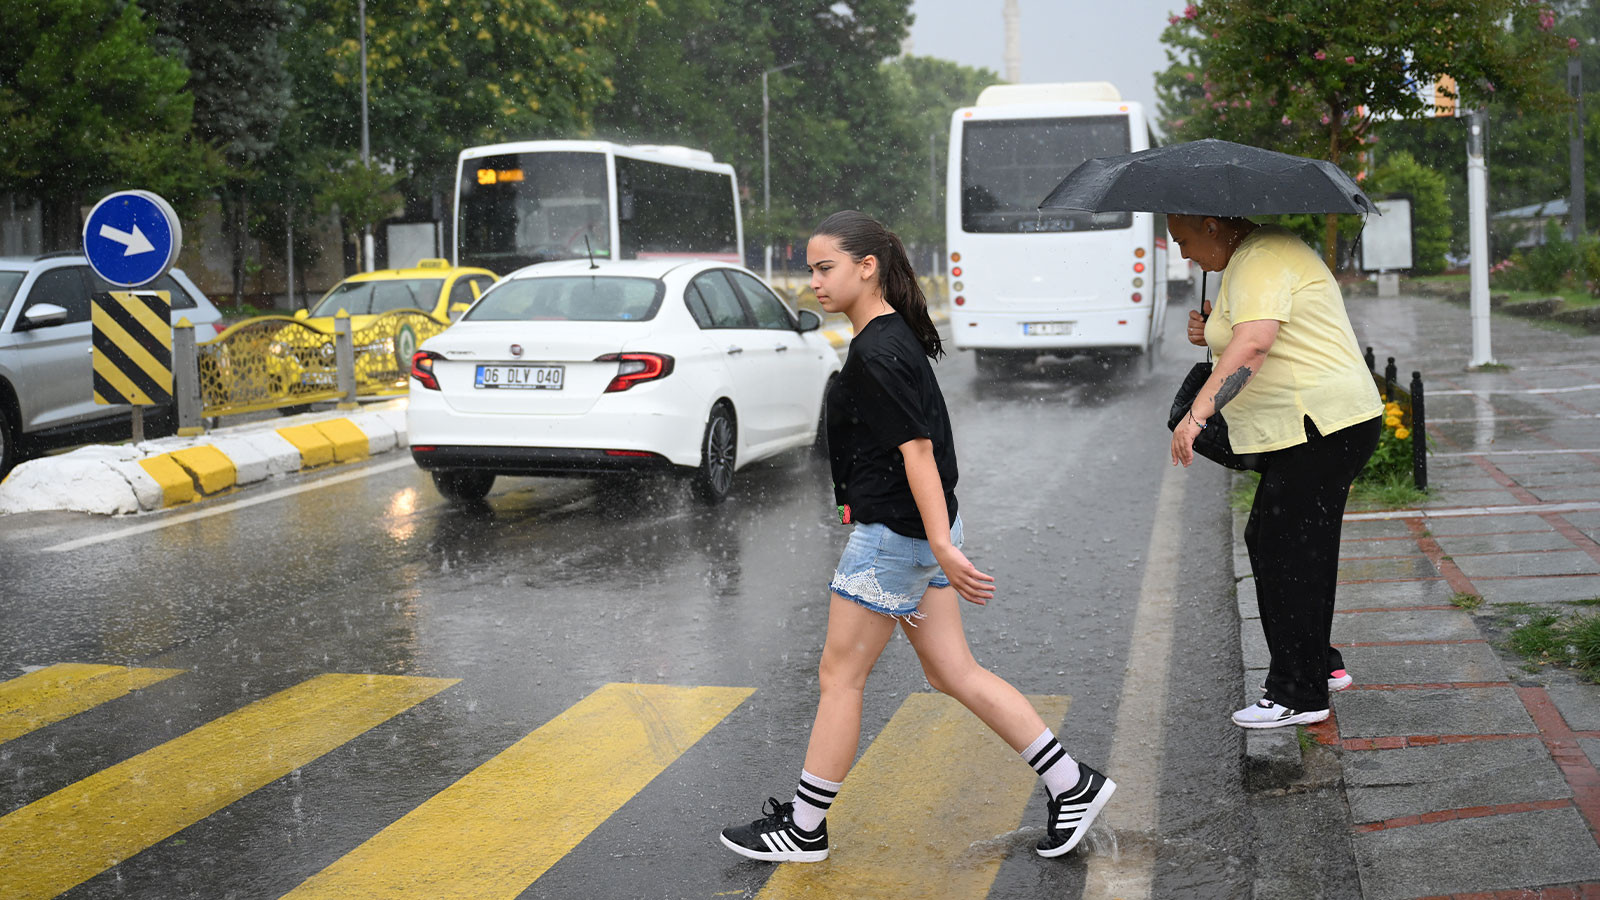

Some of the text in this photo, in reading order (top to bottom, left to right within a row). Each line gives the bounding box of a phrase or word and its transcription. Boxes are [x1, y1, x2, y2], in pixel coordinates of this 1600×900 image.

[1018, 220, 1074, 232] ISUZU
[484, 368, 560, 384] 06 DLV 040
